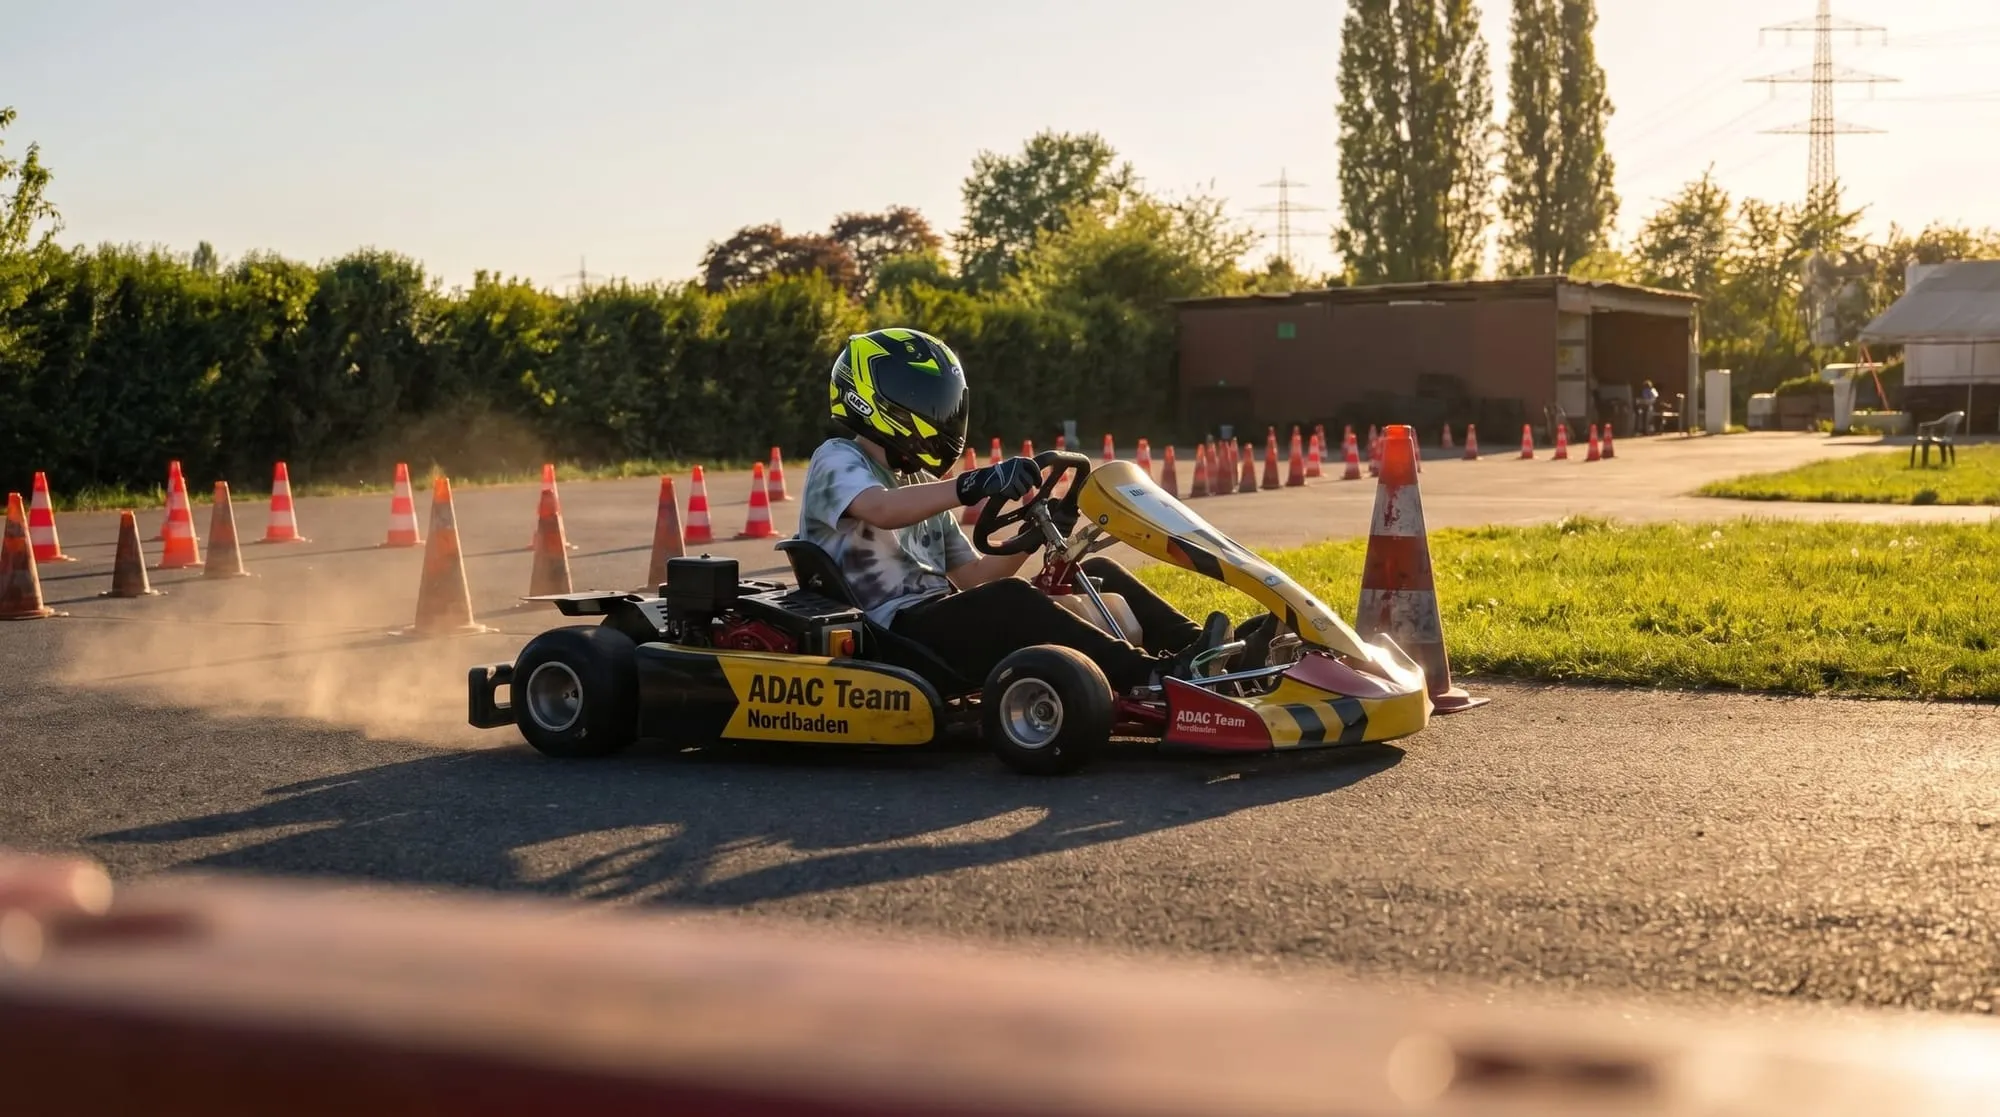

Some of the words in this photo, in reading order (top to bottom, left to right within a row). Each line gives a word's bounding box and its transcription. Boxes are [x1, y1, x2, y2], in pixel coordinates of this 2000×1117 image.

[748, 674, 824, 707] ADAC
[834, 679, 910, 711] Team
[748, 709, 848, 734] Nordbaden
[1176, 710, 1211, 724] ADAC
[1214, 713, 1245, 727] Team
[1176, 723, 1217, 734] Nordbaden
